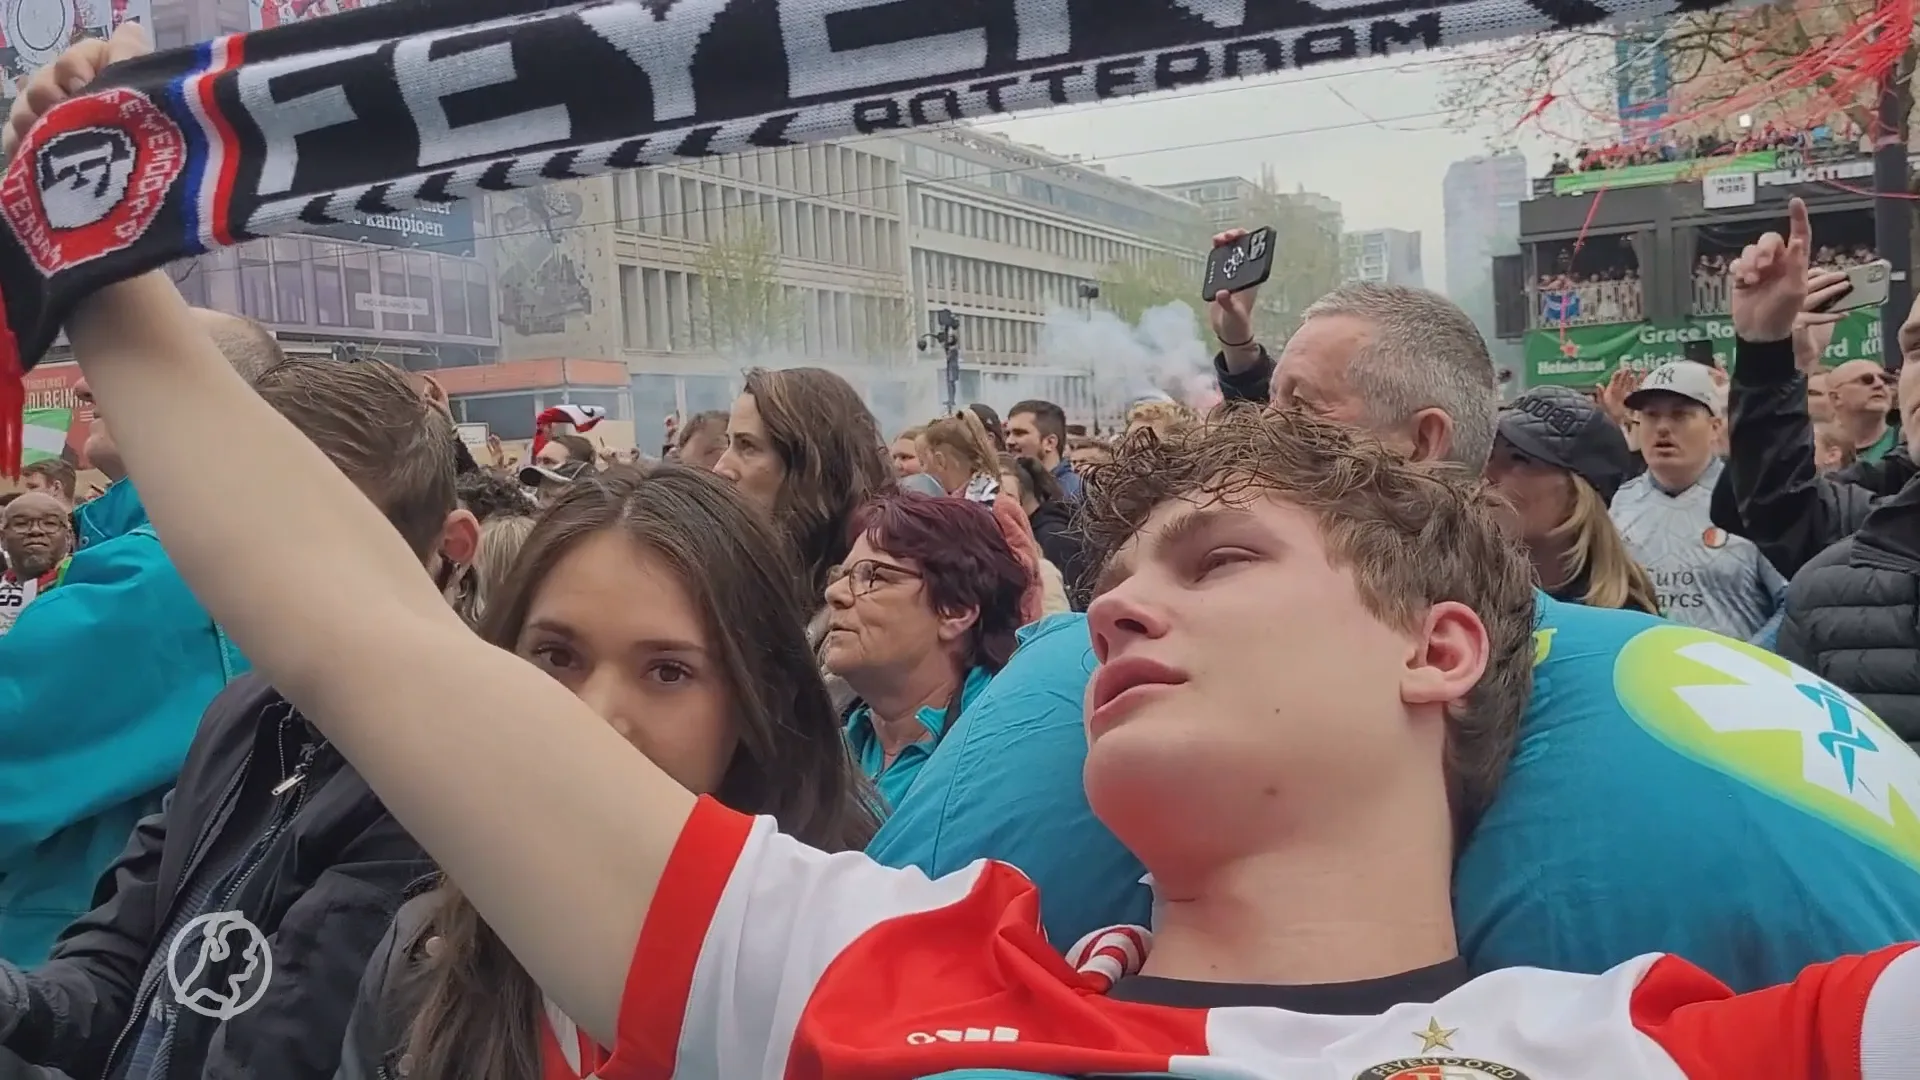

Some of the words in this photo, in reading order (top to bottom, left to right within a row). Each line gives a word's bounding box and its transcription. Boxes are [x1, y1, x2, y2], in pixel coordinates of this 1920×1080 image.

[366, 213, 444, 237] kampioen
[1638, 326, 1701, 344] Grace
[1537, 361, 1606, 375] Heineken
[1656, 593, 1704, 608] arcs
[1371, 1057, 1518, 1080] FEYENOORD
